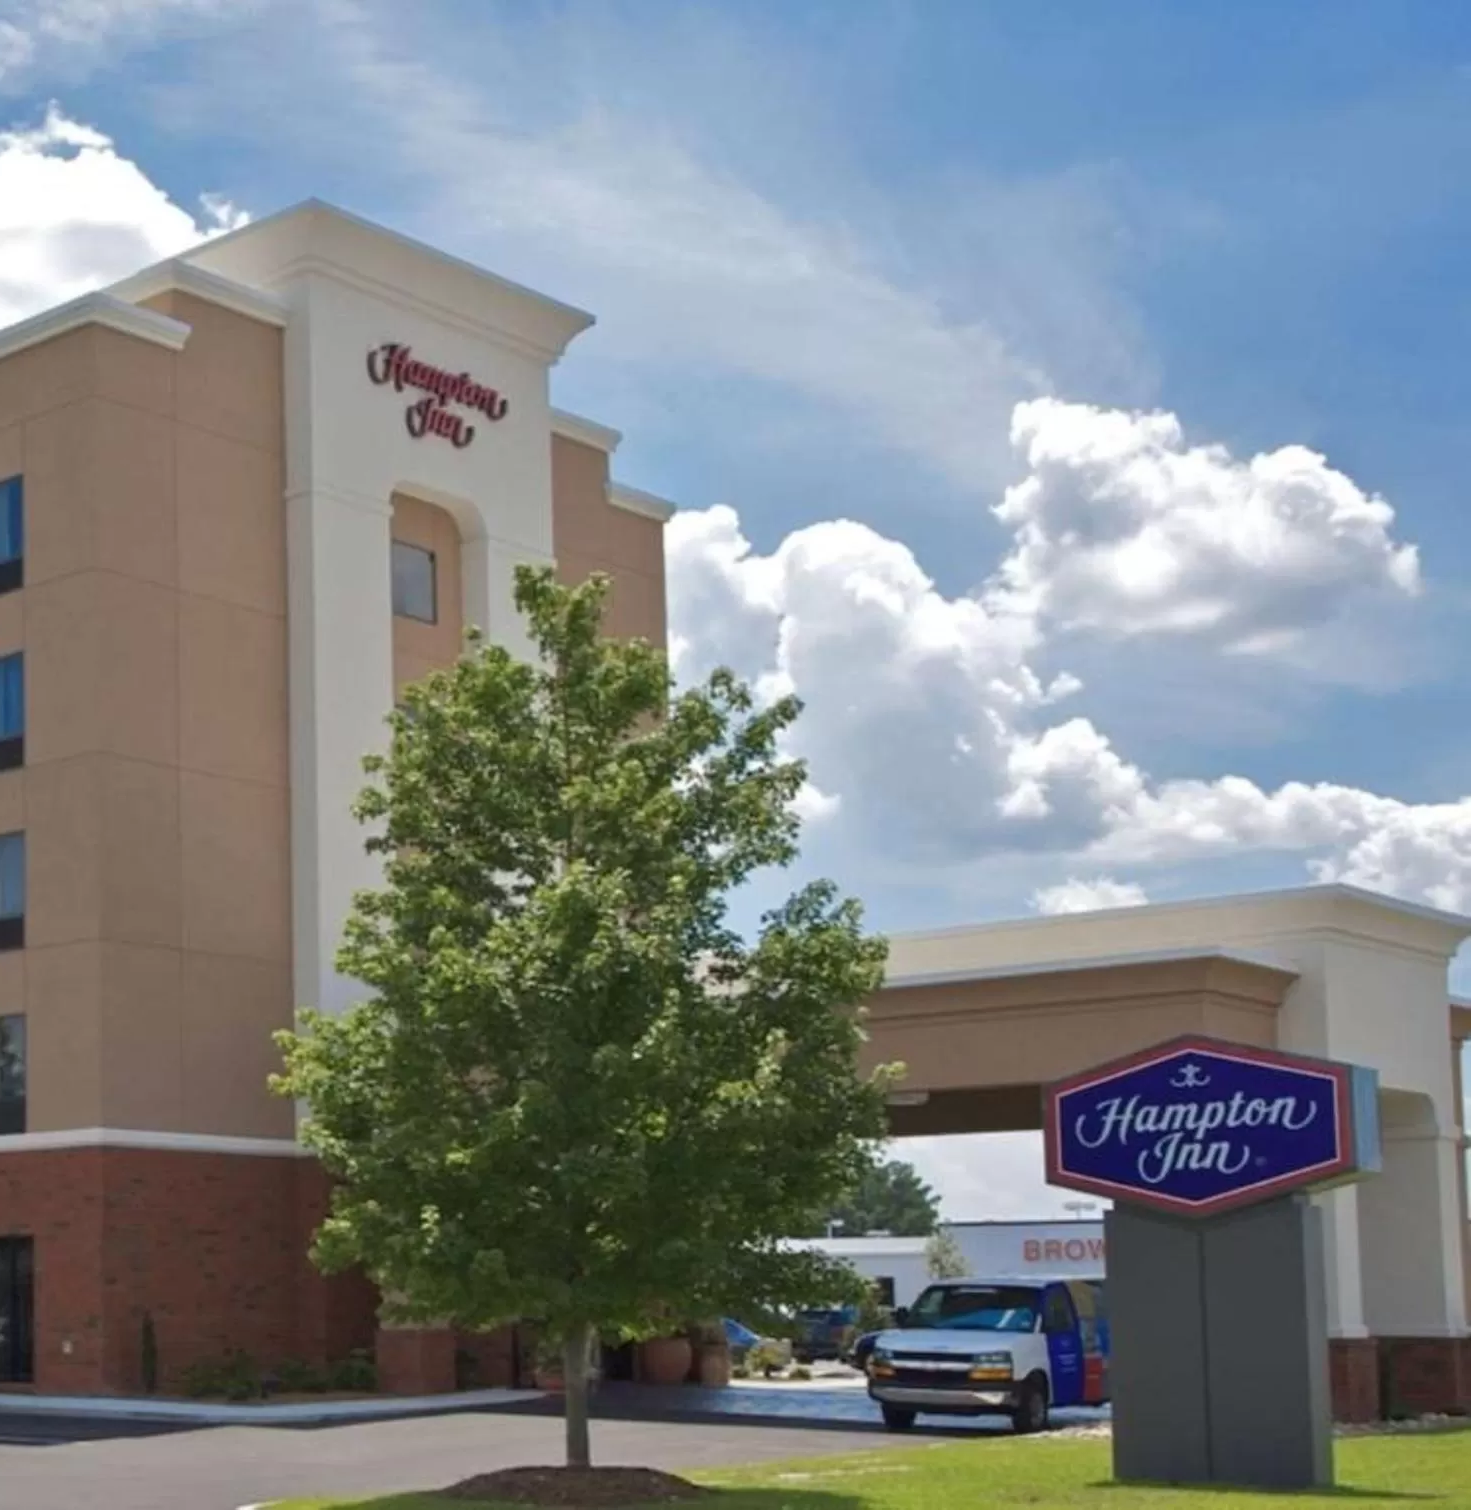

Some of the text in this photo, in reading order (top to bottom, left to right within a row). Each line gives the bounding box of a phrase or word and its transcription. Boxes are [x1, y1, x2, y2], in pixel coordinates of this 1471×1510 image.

[366, 342, 508, 421] Hampton
[406, 398, 474, 449] Inn
[1075, 1092, 1316, 1148] Hampton
[1138, 1131, 1250, 1184] Inn
